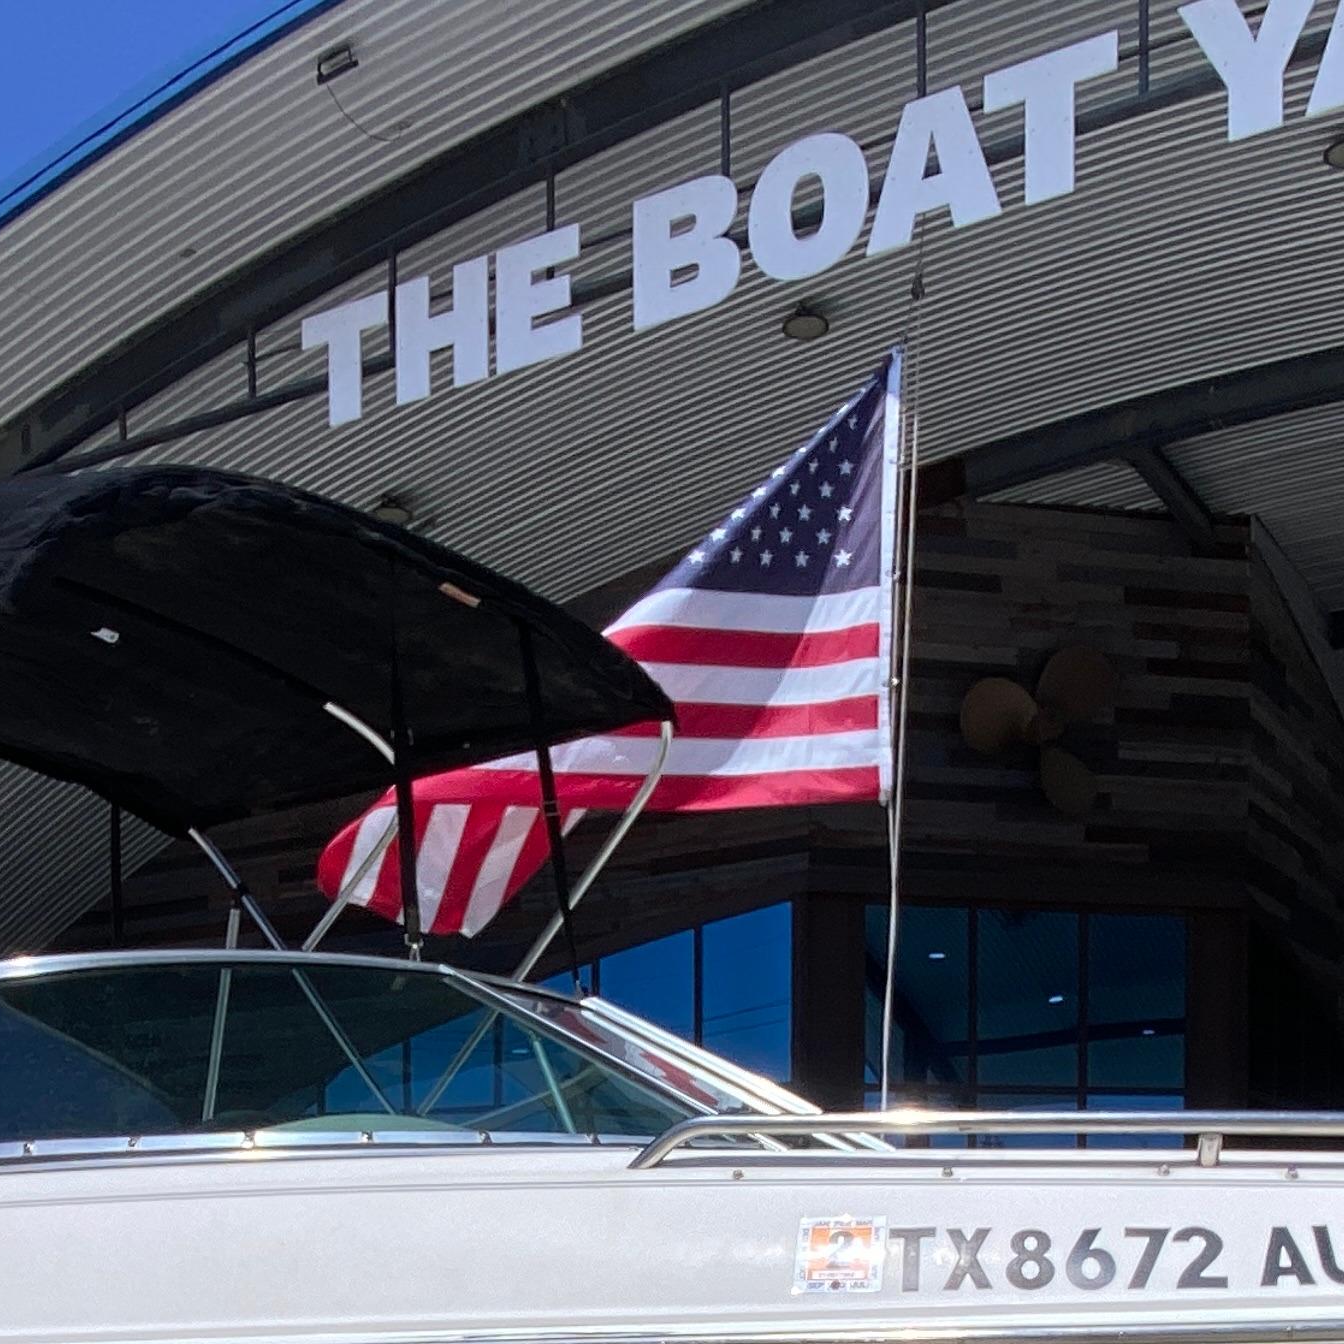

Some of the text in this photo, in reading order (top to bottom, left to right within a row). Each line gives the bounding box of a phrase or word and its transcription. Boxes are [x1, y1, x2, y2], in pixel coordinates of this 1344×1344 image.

[302, 223, 583, 428] THE
[633, 30, 1118, 331] BOAT
[888, 1226, 1229, 1293] TX8672
